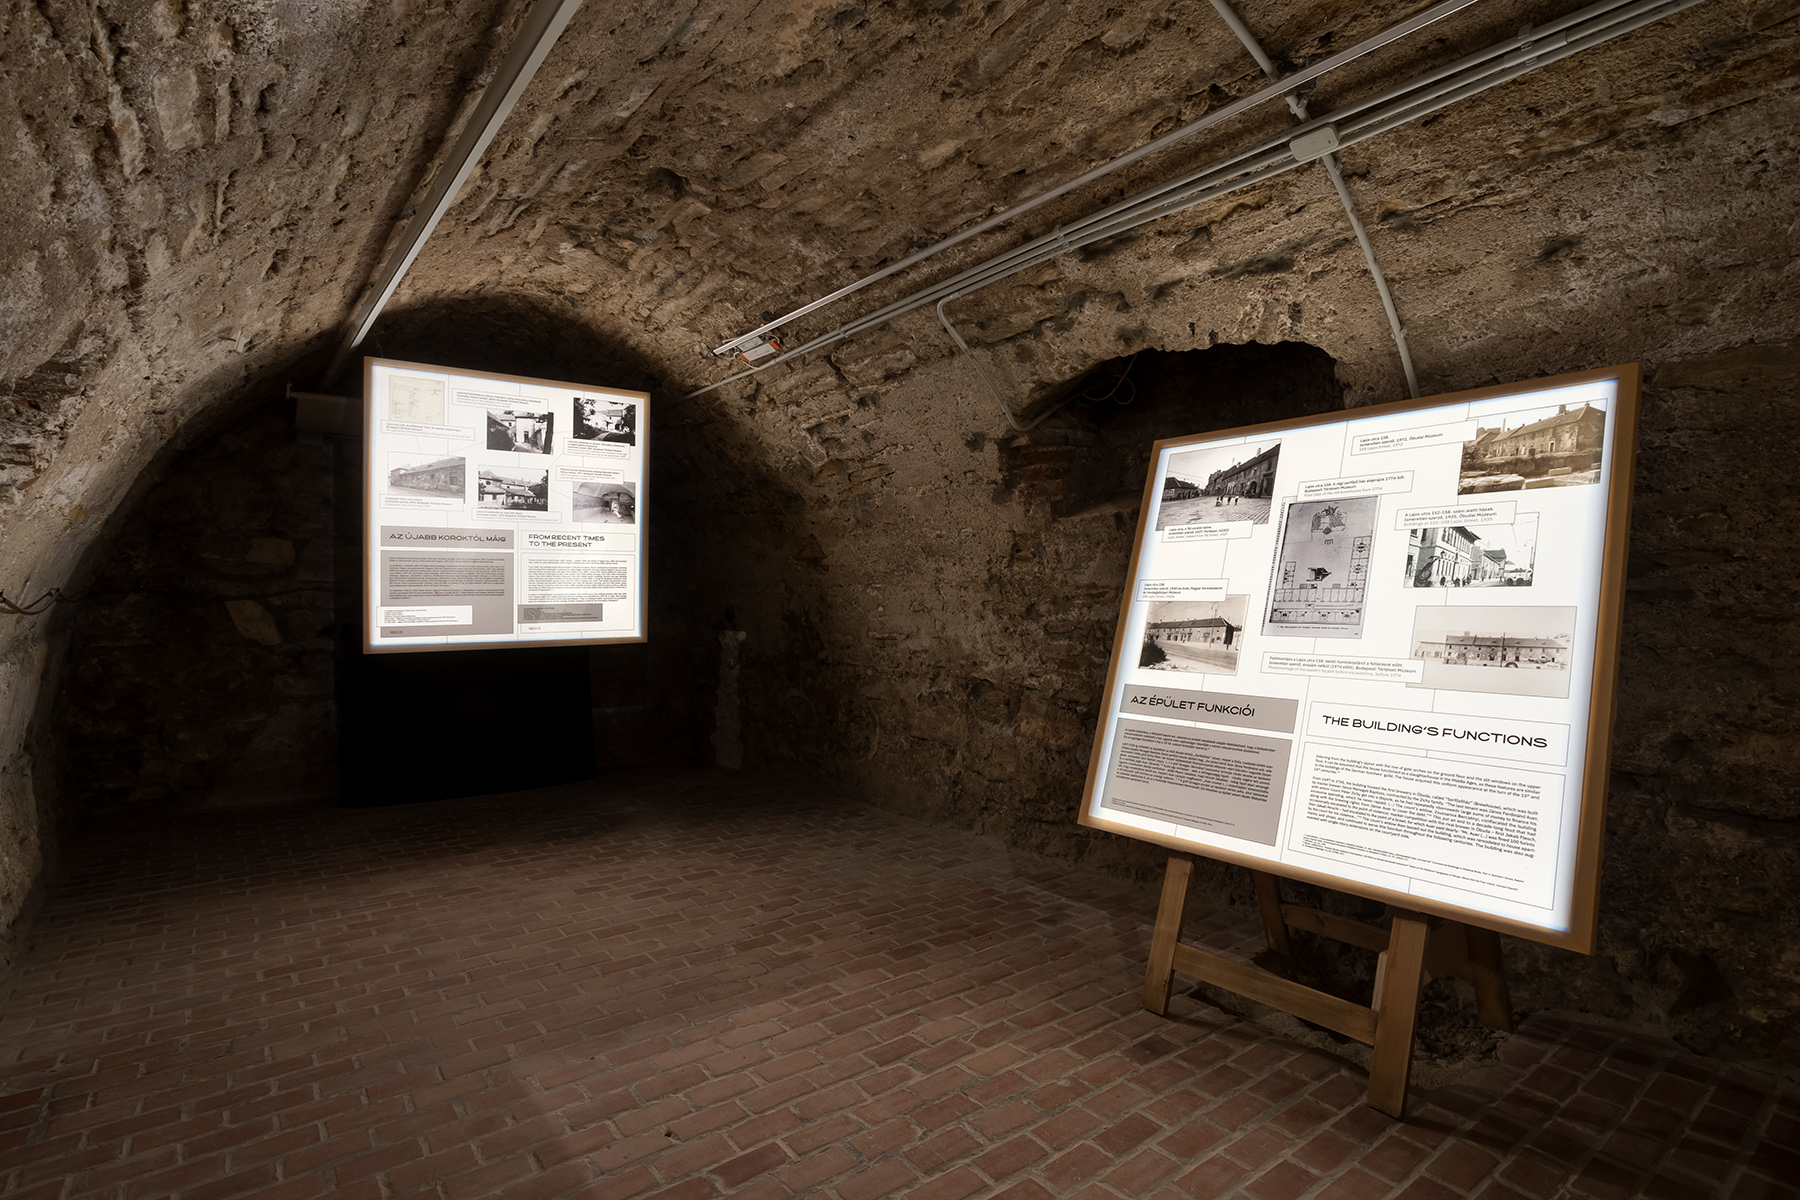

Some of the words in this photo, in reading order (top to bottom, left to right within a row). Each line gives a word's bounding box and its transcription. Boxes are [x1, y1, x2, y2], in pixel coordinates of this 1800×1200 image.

[404, 532, 437, 541] ÚJABB
[438, 534, 485, 542] KOROKTÓL
[486, 534, 506, 542] MÁIG
[1130, 696, 1148, 705] AZ
[1148, 694, 1196, 710] ÉPÜLET
[1196, 702, 1255, 717] FUNKCIÓI
[1322, 715, 1350, 727] THE
[1352, 718, 1439, 736] BUILDING'S
[1442, 728, 1548, 748] FUNCTIONS
